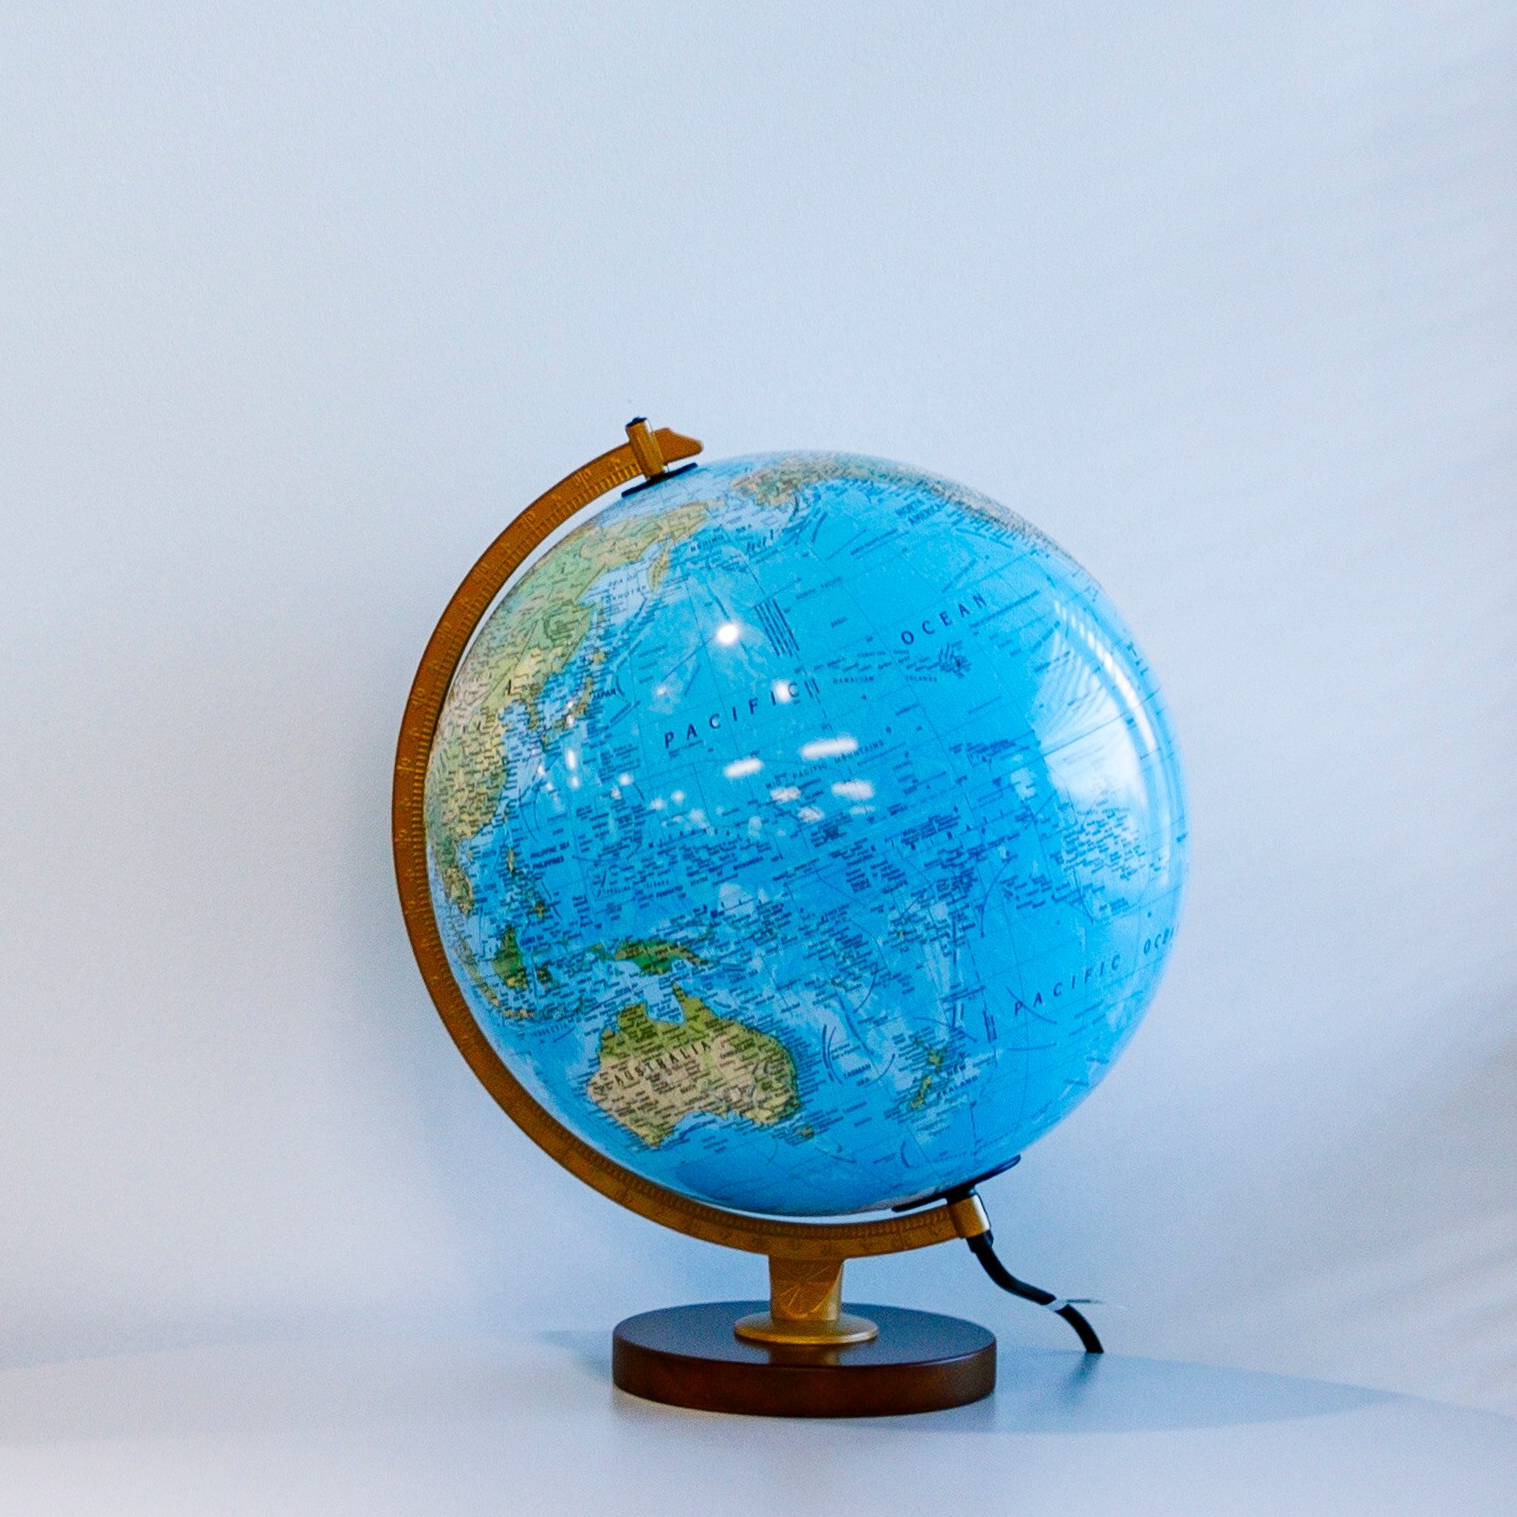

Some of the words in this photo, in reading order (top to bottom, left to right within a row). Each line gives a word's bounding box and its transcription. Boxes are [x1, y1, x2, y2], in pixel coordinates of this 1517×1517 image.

[592, 687, 617, 701] JAPAN
[664, 681, 801, 750] PACIFIC
[900, 593, 987, 646] OCEAN
[1014, 953, 1122, 1016] PACIFIC
[614, 1039, 711, 1087] AUSTRALIA
